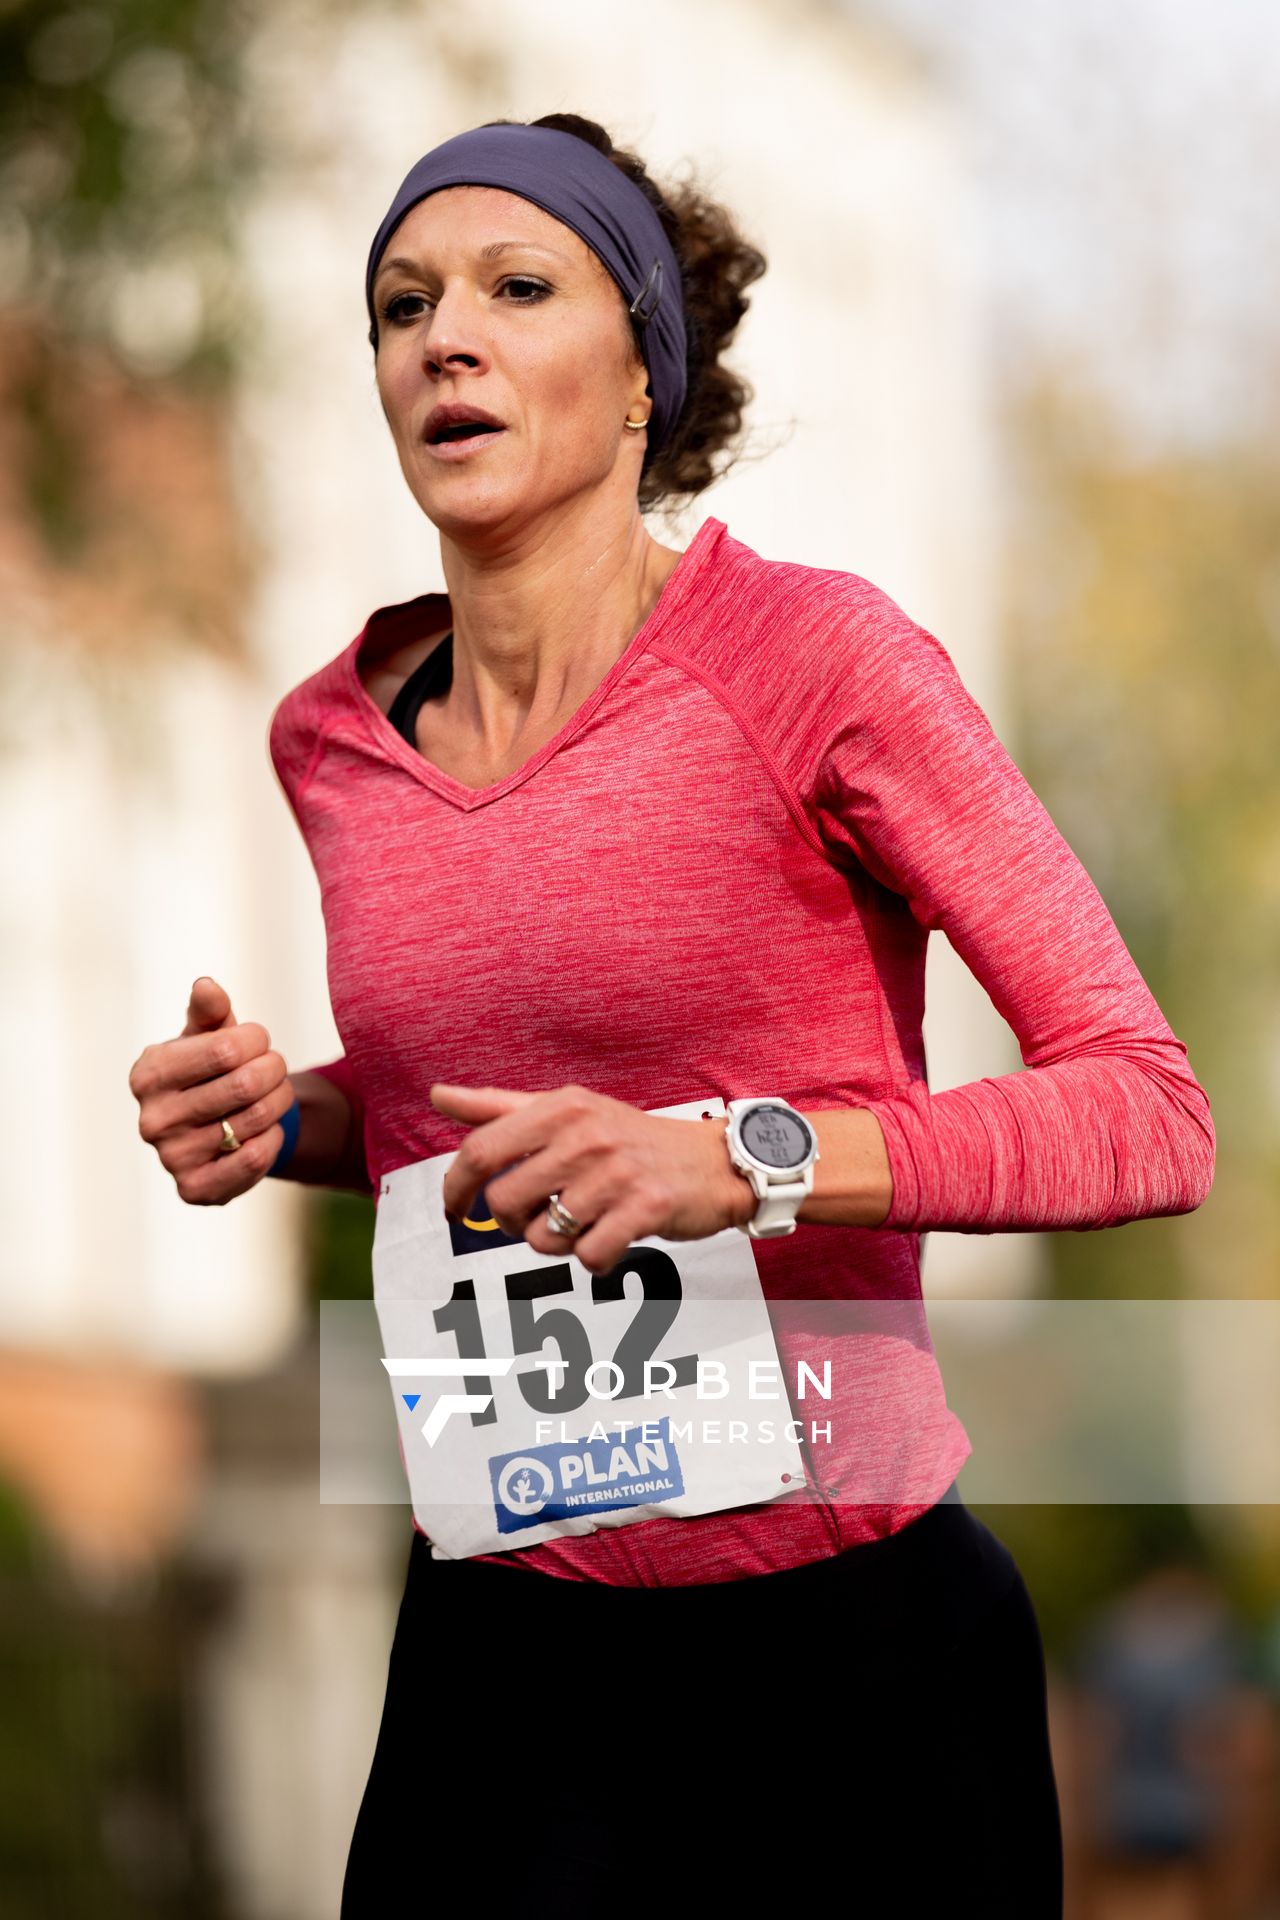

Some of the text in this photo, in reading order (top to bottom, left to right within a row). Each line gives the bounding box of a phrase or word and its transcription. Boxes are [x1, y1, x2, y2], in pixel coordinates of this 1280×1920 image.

[432, 1246, 699, 1427] 152
[558, 1438, 669, 1489] PLAN
[565, 1477, 673, 1508] INTERNATIONAL
